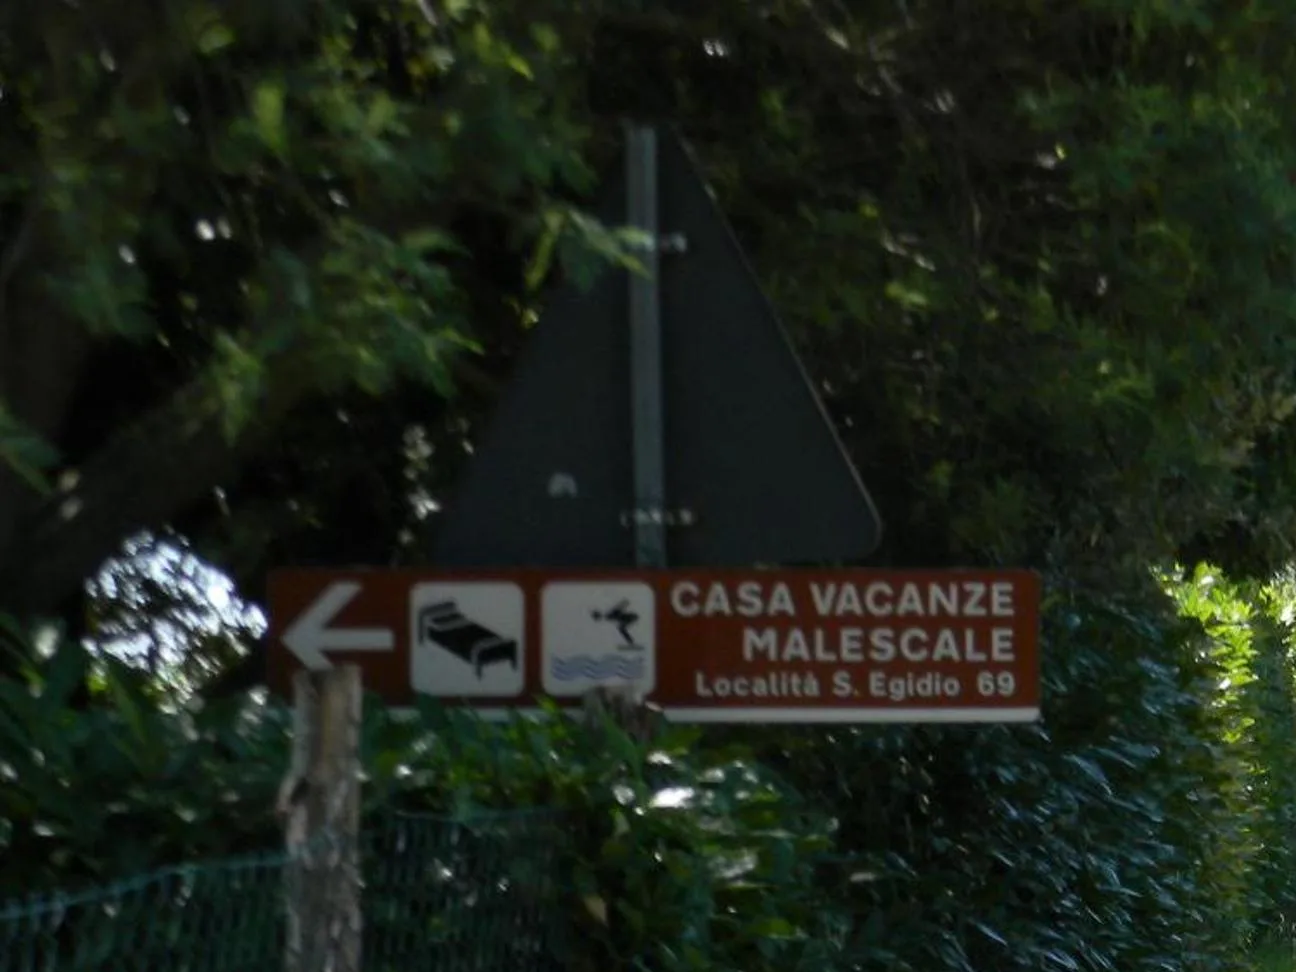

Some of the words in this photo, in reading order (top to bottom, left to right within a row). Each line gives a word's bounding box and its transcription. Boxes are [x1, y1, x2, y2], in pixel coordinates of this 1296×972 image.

[670, 581, 796, 617] CASA
[809, 581, 1015, 616] VACANZE
[742, 627, 1015, 662] MALESCALE
[696, 671, 820, 697] Località
[832, 671, 860, 697] S.
[869, 671, 960, 701] Egidio
[977, 671, 1015, 697] 69
